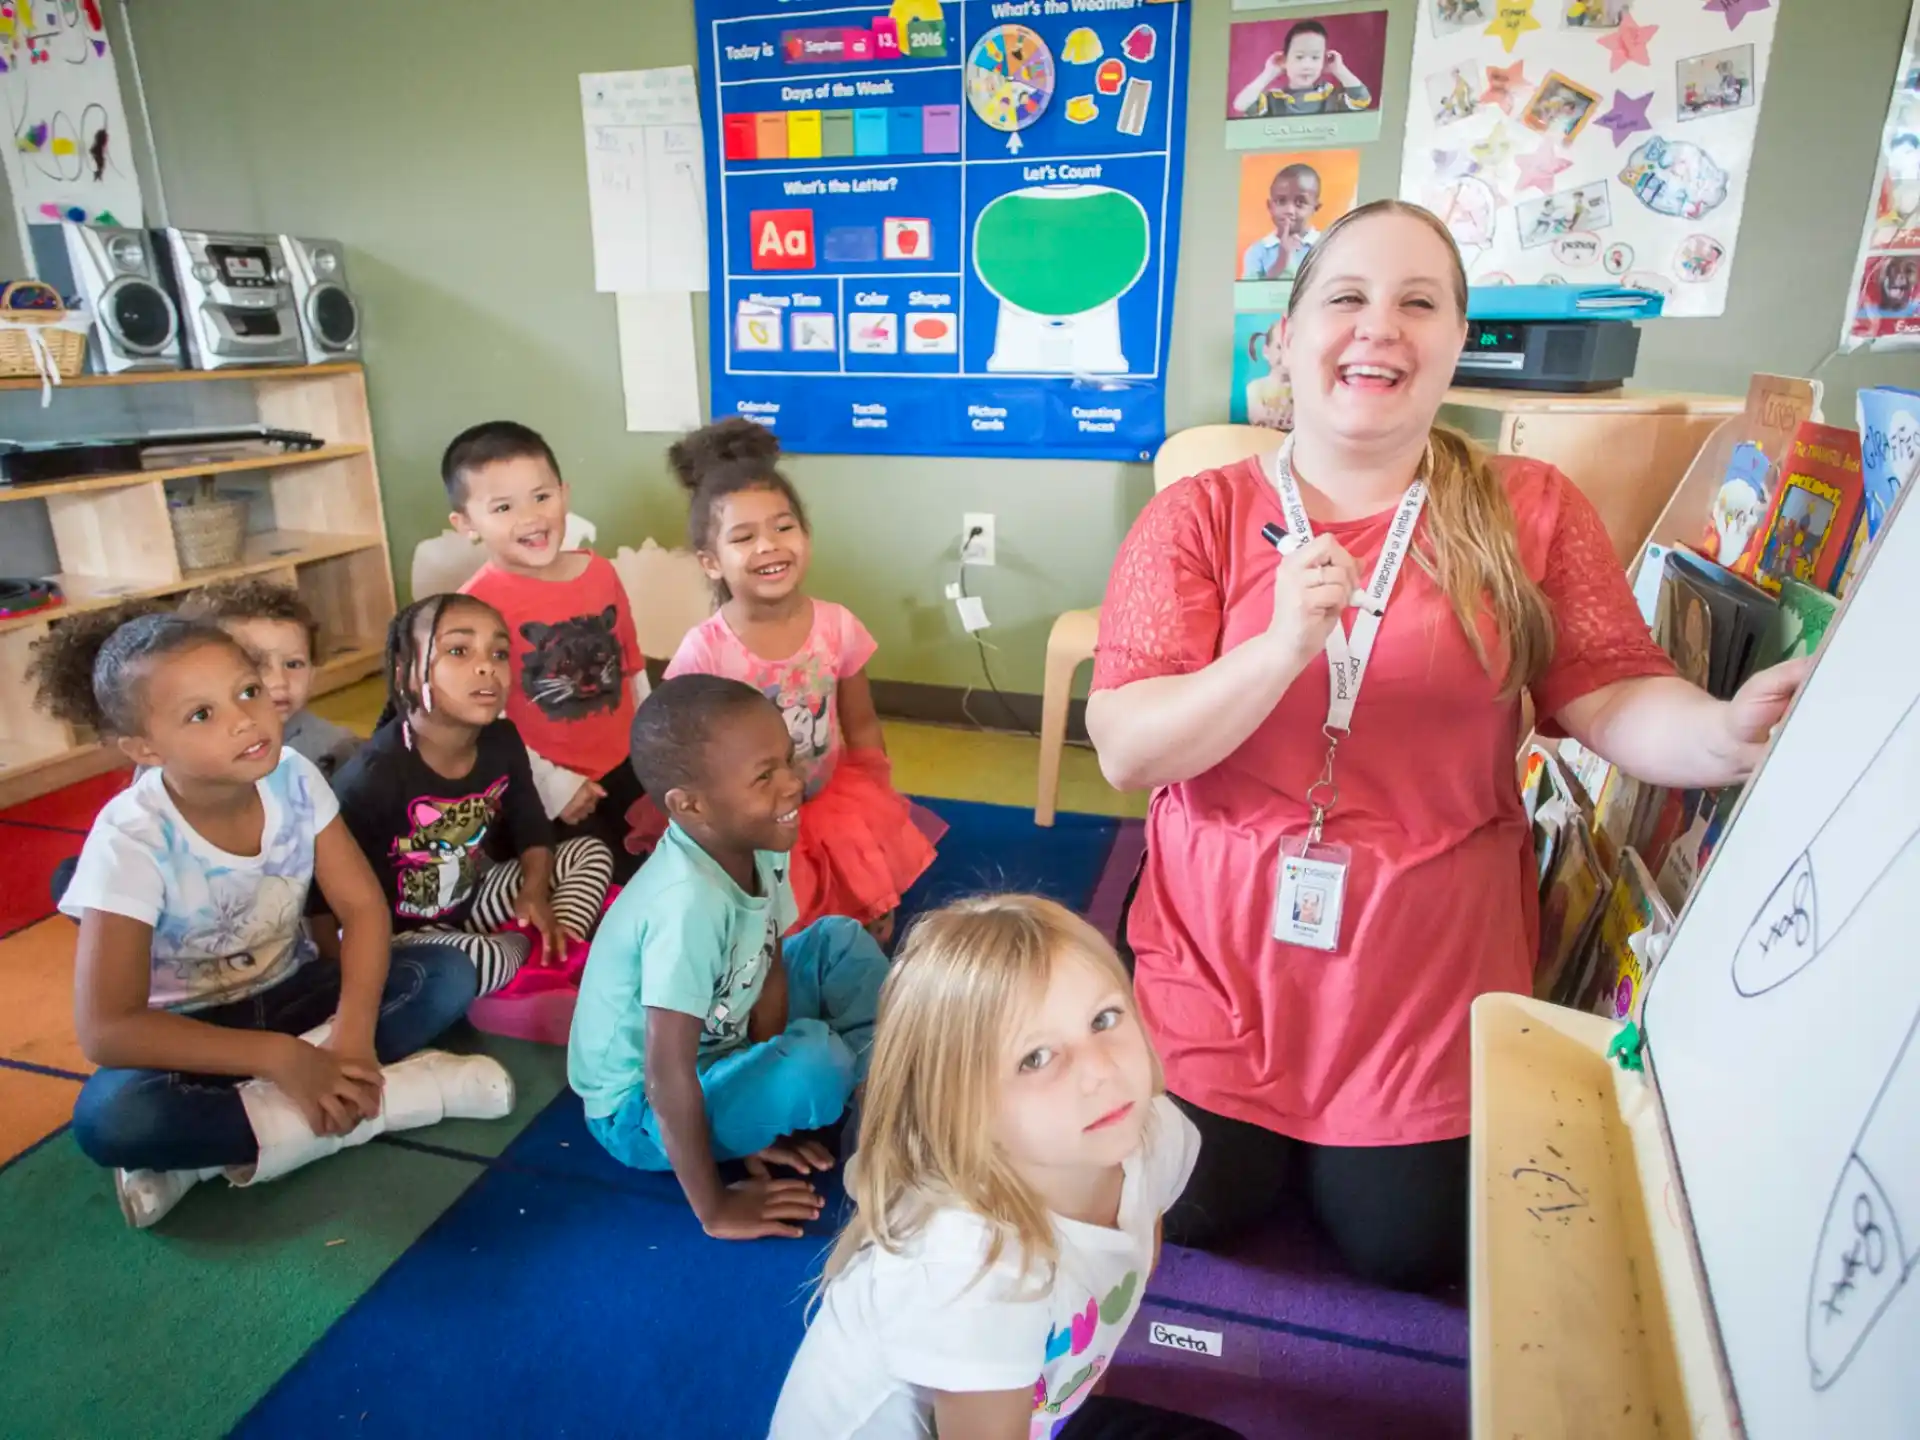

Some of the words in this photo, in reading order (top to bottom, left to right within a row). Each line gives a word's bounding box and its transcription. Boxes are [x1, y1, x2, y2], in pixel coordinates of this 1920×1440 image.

[991, 1, 1041, 19] What's
[1044, 1, 1069, 15] the
[726, 45, 760, 61] Today
[762, 43, 774, 56] is
[910, 32, 942, 48] 2016
[782, 86, 813, 103] Days
[815, 83, 829, 98] of
[832, 82, 854, 97] the
[856, 79, 894, 95] Week
[783, 180, 826, 195] What's
[829, 178, 851, 193] the
[852, 176, 898, 192] Letter?
[1023, 166, 1056, 181] Let's
[1059, 164, 1102, 180] Count
[758, 221, 807, 256] Aa
[1373, 551, 1398, 600] education
[1154, 1324, 1208, 1352] Greta
